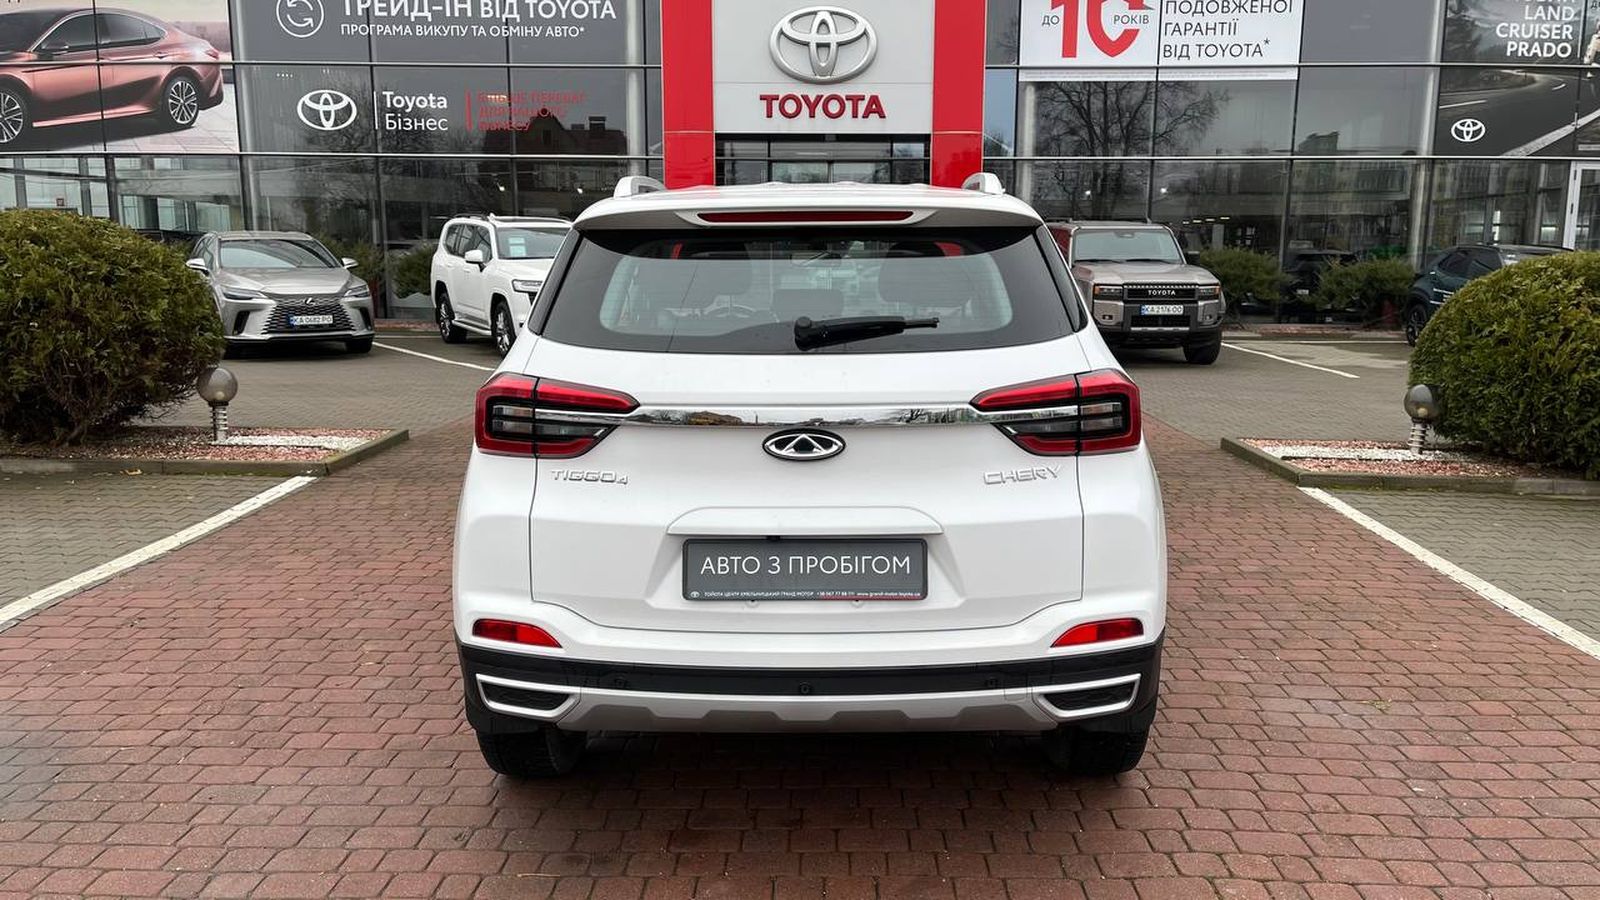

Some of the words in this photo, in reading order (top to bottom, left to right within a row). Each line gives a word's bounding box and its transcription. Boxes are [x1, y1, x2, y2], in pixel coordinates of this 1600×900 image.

[480, 0, 520, 22] ВІД
[525, 0, 617, 19] TOYOTA
[1525, 4, 1575, 20] LAND
[1042, 15, 1060, 26] ДО
[1113, 14, 1150, 25] РОКІВ
[1164, 18, 1239, 36] ГАРАНТІЇ
[341, 23, 413, 36] ПРОГРАМА
[415, 24, 468, 37] ВИКУПУ
[471, 25, 487, 36] ТА
[489, 25, 542, 37] ОБМІНУ
[1495, 22, 1573, 39] CRUISER
[1163, 44, 1191, 60] ВІД
[1506, 40, 1572, 57] PRADO
[382, 91, 448, 115] Toyota
[759, 93, 886, 119] TOYOTA
[385, 114, 448, 131] Бізнес
[983, 465, 1061, 485] CHERY
[700, 556, 761, 575] АВТО
[768, 556, 781, 575] З
[789, 555, 911, 575] ПРОБІГОМ
